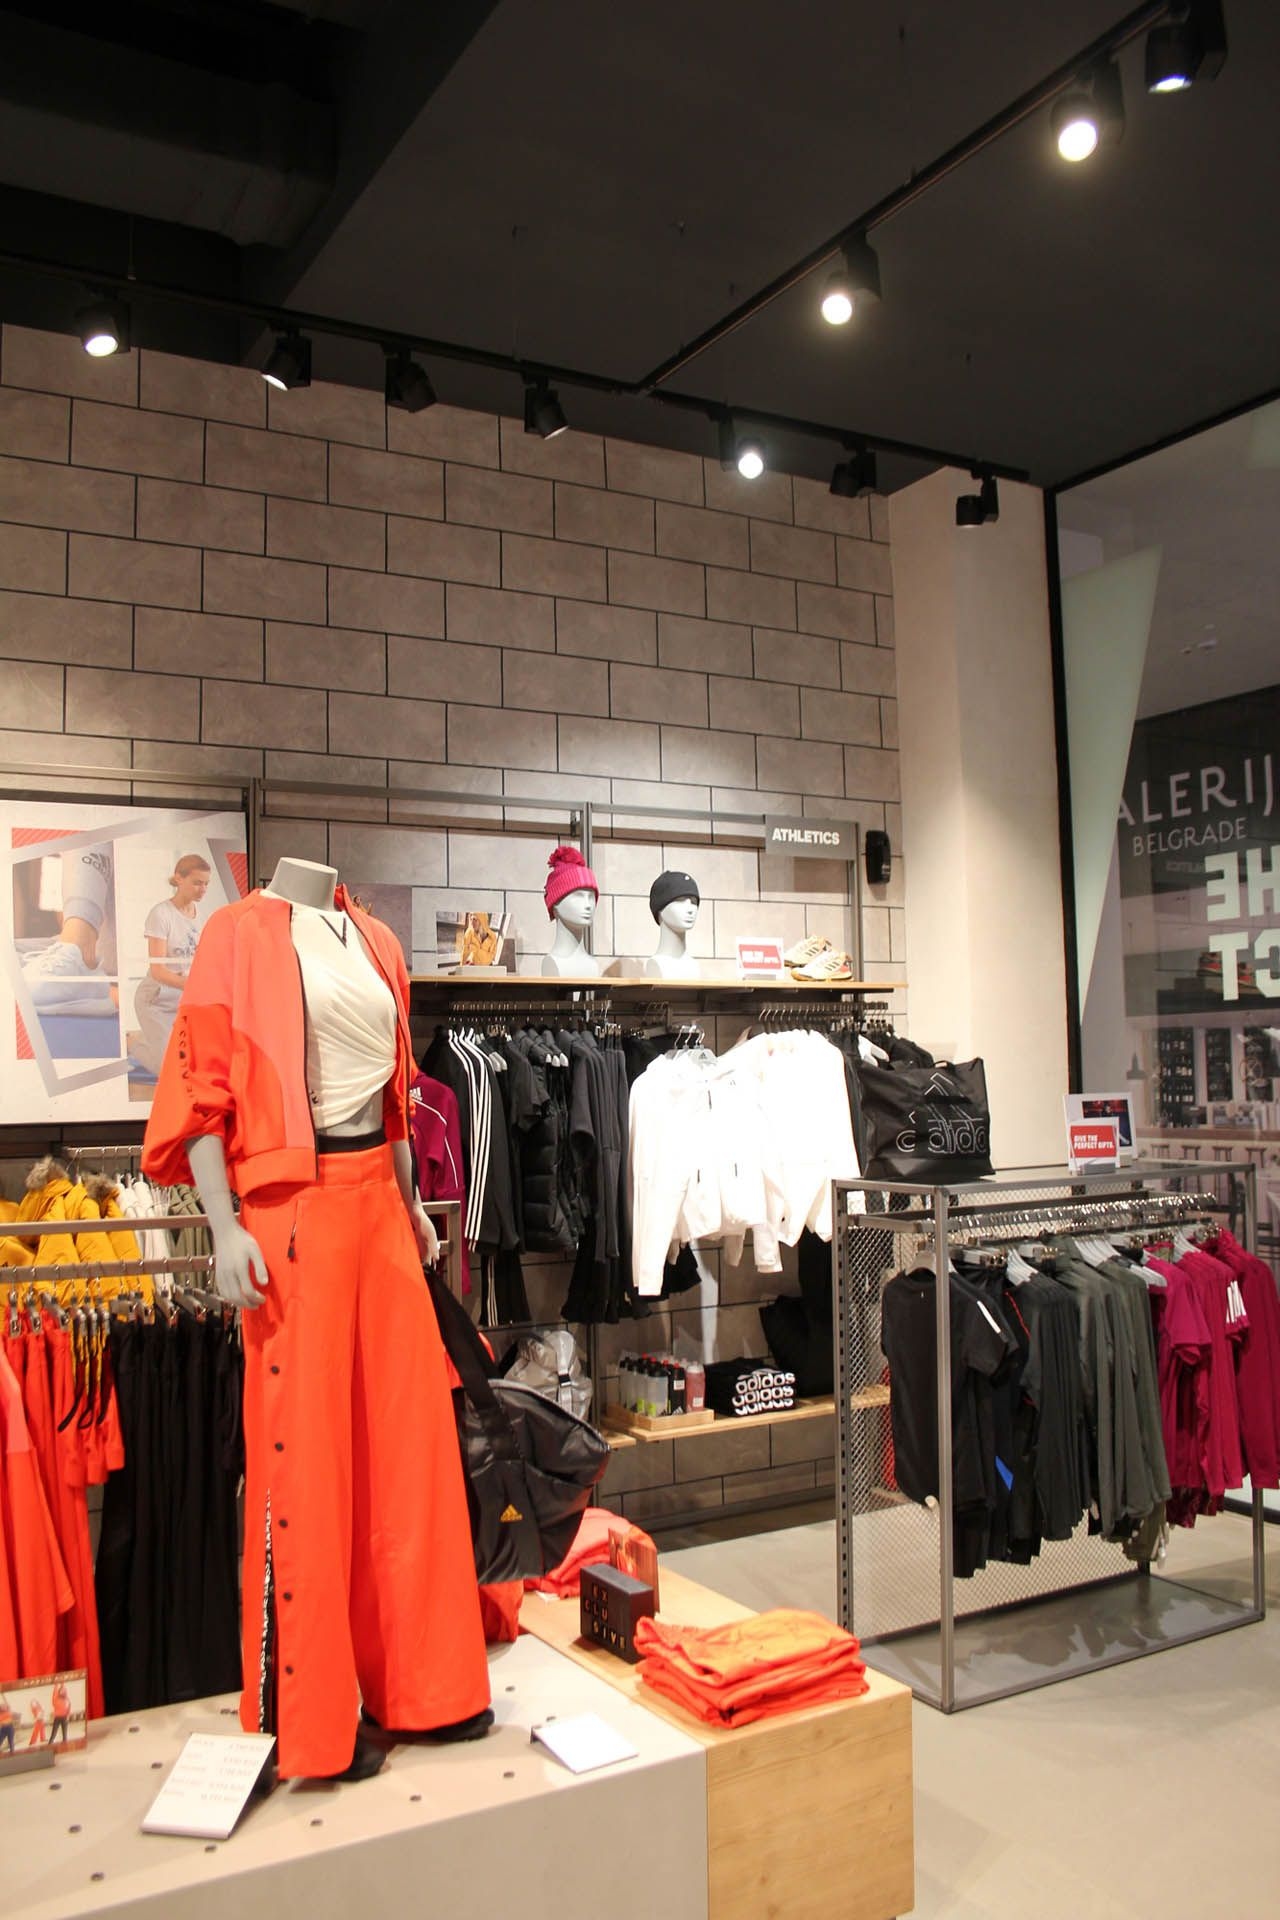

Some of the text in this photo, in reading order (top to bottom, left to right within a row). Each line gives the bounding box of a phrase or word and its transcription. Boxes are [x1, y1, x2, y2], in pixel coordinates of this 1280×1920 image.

[772, 827, 840, 846] ATHLETICS
[1132, 816, 1248, 857] BELGRADE
[1073, 1141, 1098, 1149] PERFECT
[1087, 1134, 1098, 1142] THE
[735, 1371, 796, 1394] adidas
[584, 1598, 609, 1621] CLU
[593, 1620, 626, 1649] SIVE
